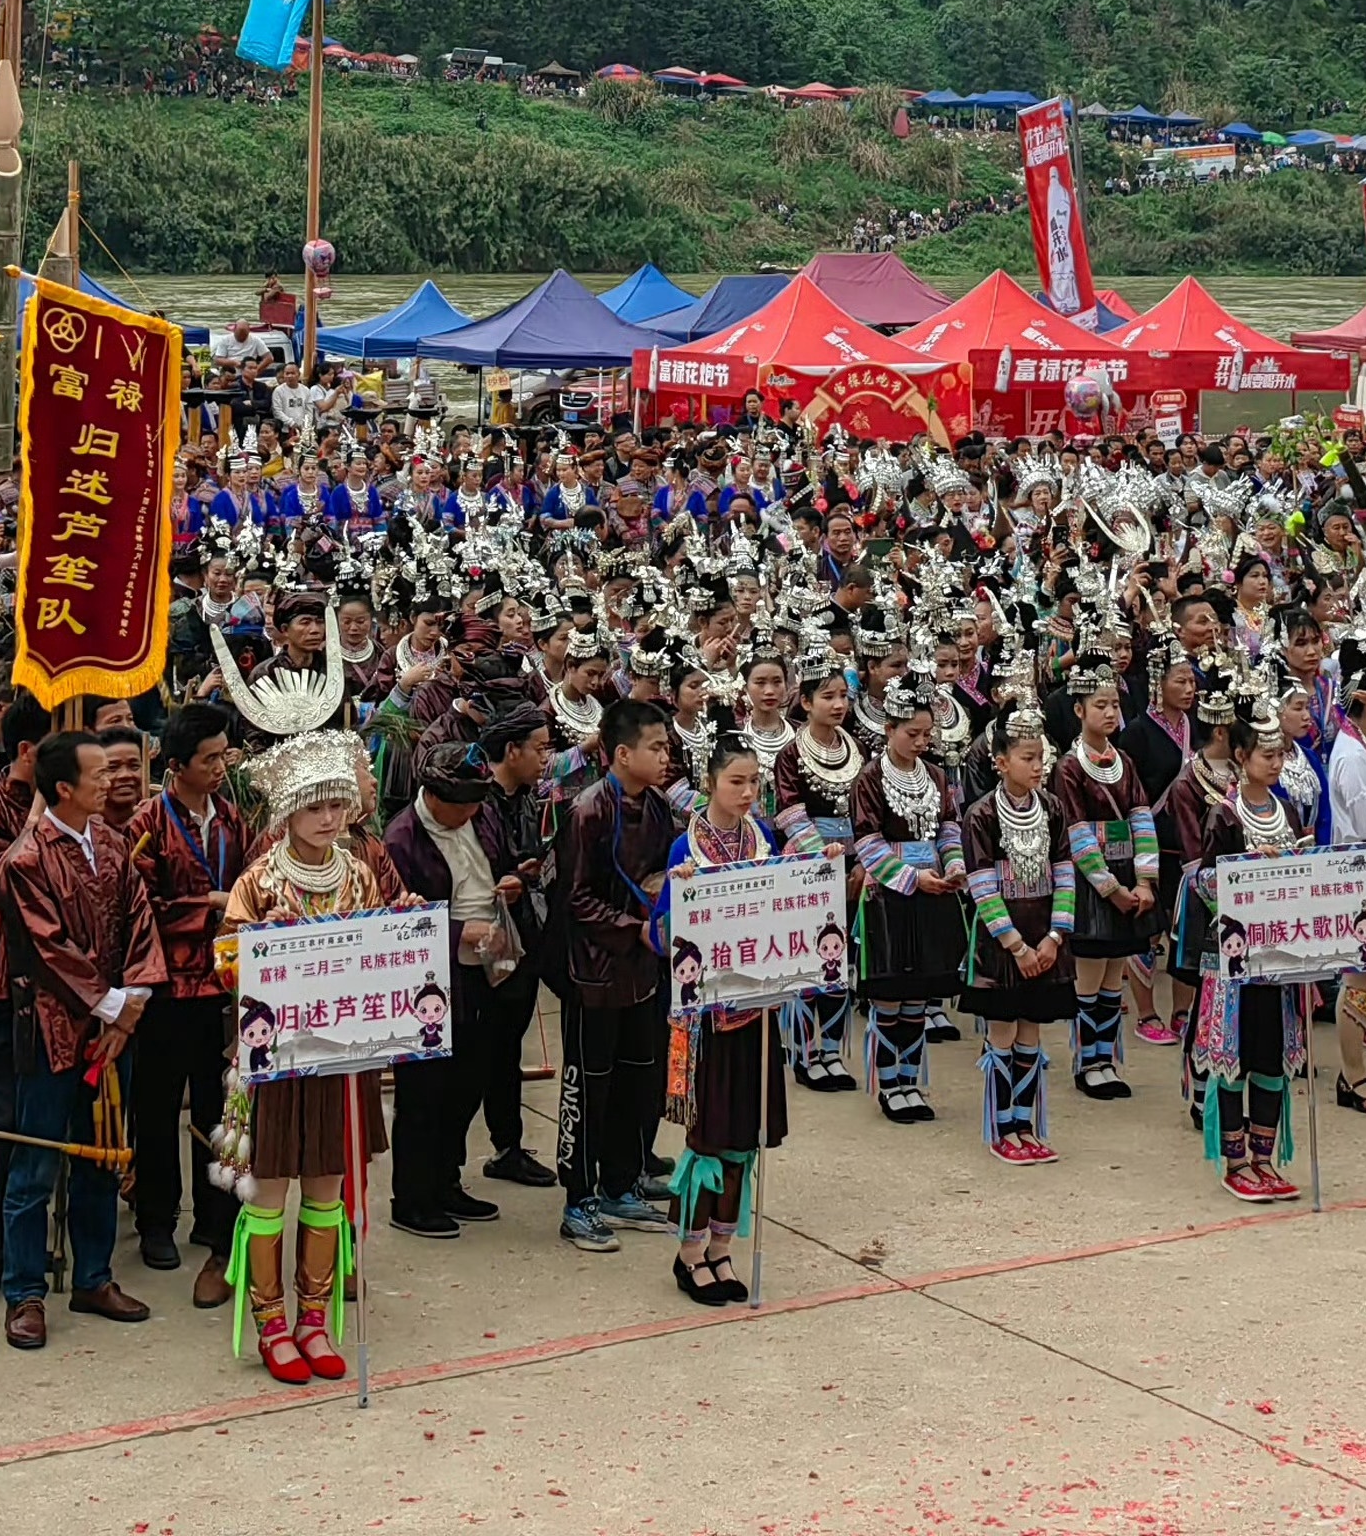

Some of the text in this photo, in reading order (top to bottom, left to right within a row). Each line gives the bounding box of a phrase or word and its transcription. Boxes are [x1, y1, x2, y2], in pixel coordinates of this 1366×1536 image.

[49, 363, 145, 413] 富禄
[658, 359, 731, 387] 富禄花炮节
[1013, 358, 1128, 382] 富禄花节
[36, 423, 120, 635] 归述芦笙队
[710, 929, 811, 970] 抬官人队
[1246, 914, 1355, 947] 侗族大歌队
[275, 989, 417, 1034] 归述芦笙队
